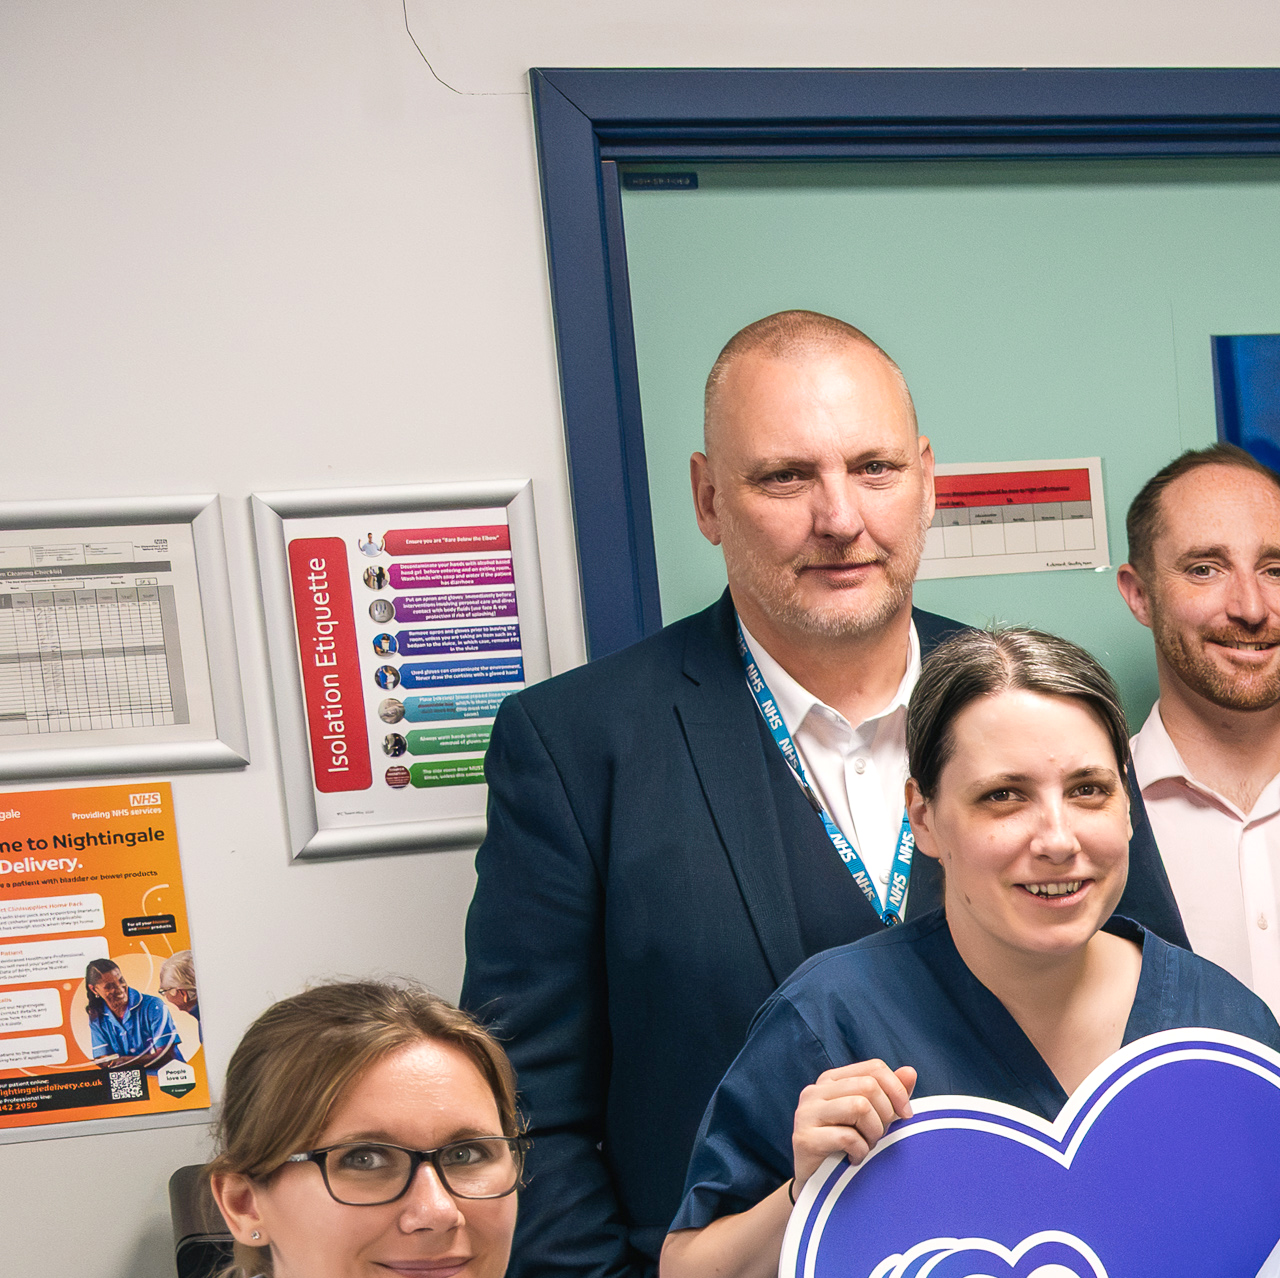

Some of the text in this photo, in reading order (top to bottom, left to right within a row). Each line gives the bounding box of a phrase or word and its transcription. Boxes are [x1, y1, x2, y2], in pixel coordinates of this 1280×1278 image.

[308, 558, 350, 772] Isolation Etiquette
[746, 663, 765, 693] NHS
[762, 699, 783, 730] NHS
[779, 737, 799, 769] NHS
[72, 807, 161, 820] Providing NHS services
[131, 793, 160, 806] NHS
[27, 827, 164, 851] to Nightingale
[830, 833, 857, 863] NHS
[898, 831, 915, 865] NHS
[0, 857, 83, 875] Delivery.
[12, 878, 39, 888] patient
[60, 875, 89, 884] bladder
[100, 872, 122, 880] bowel
[124, 870, 158, 879] products
[852, 870, 876, 902] NHS
[889, 871, 906, 907] NHS
[16, 1102, 37, 1110] 2950
